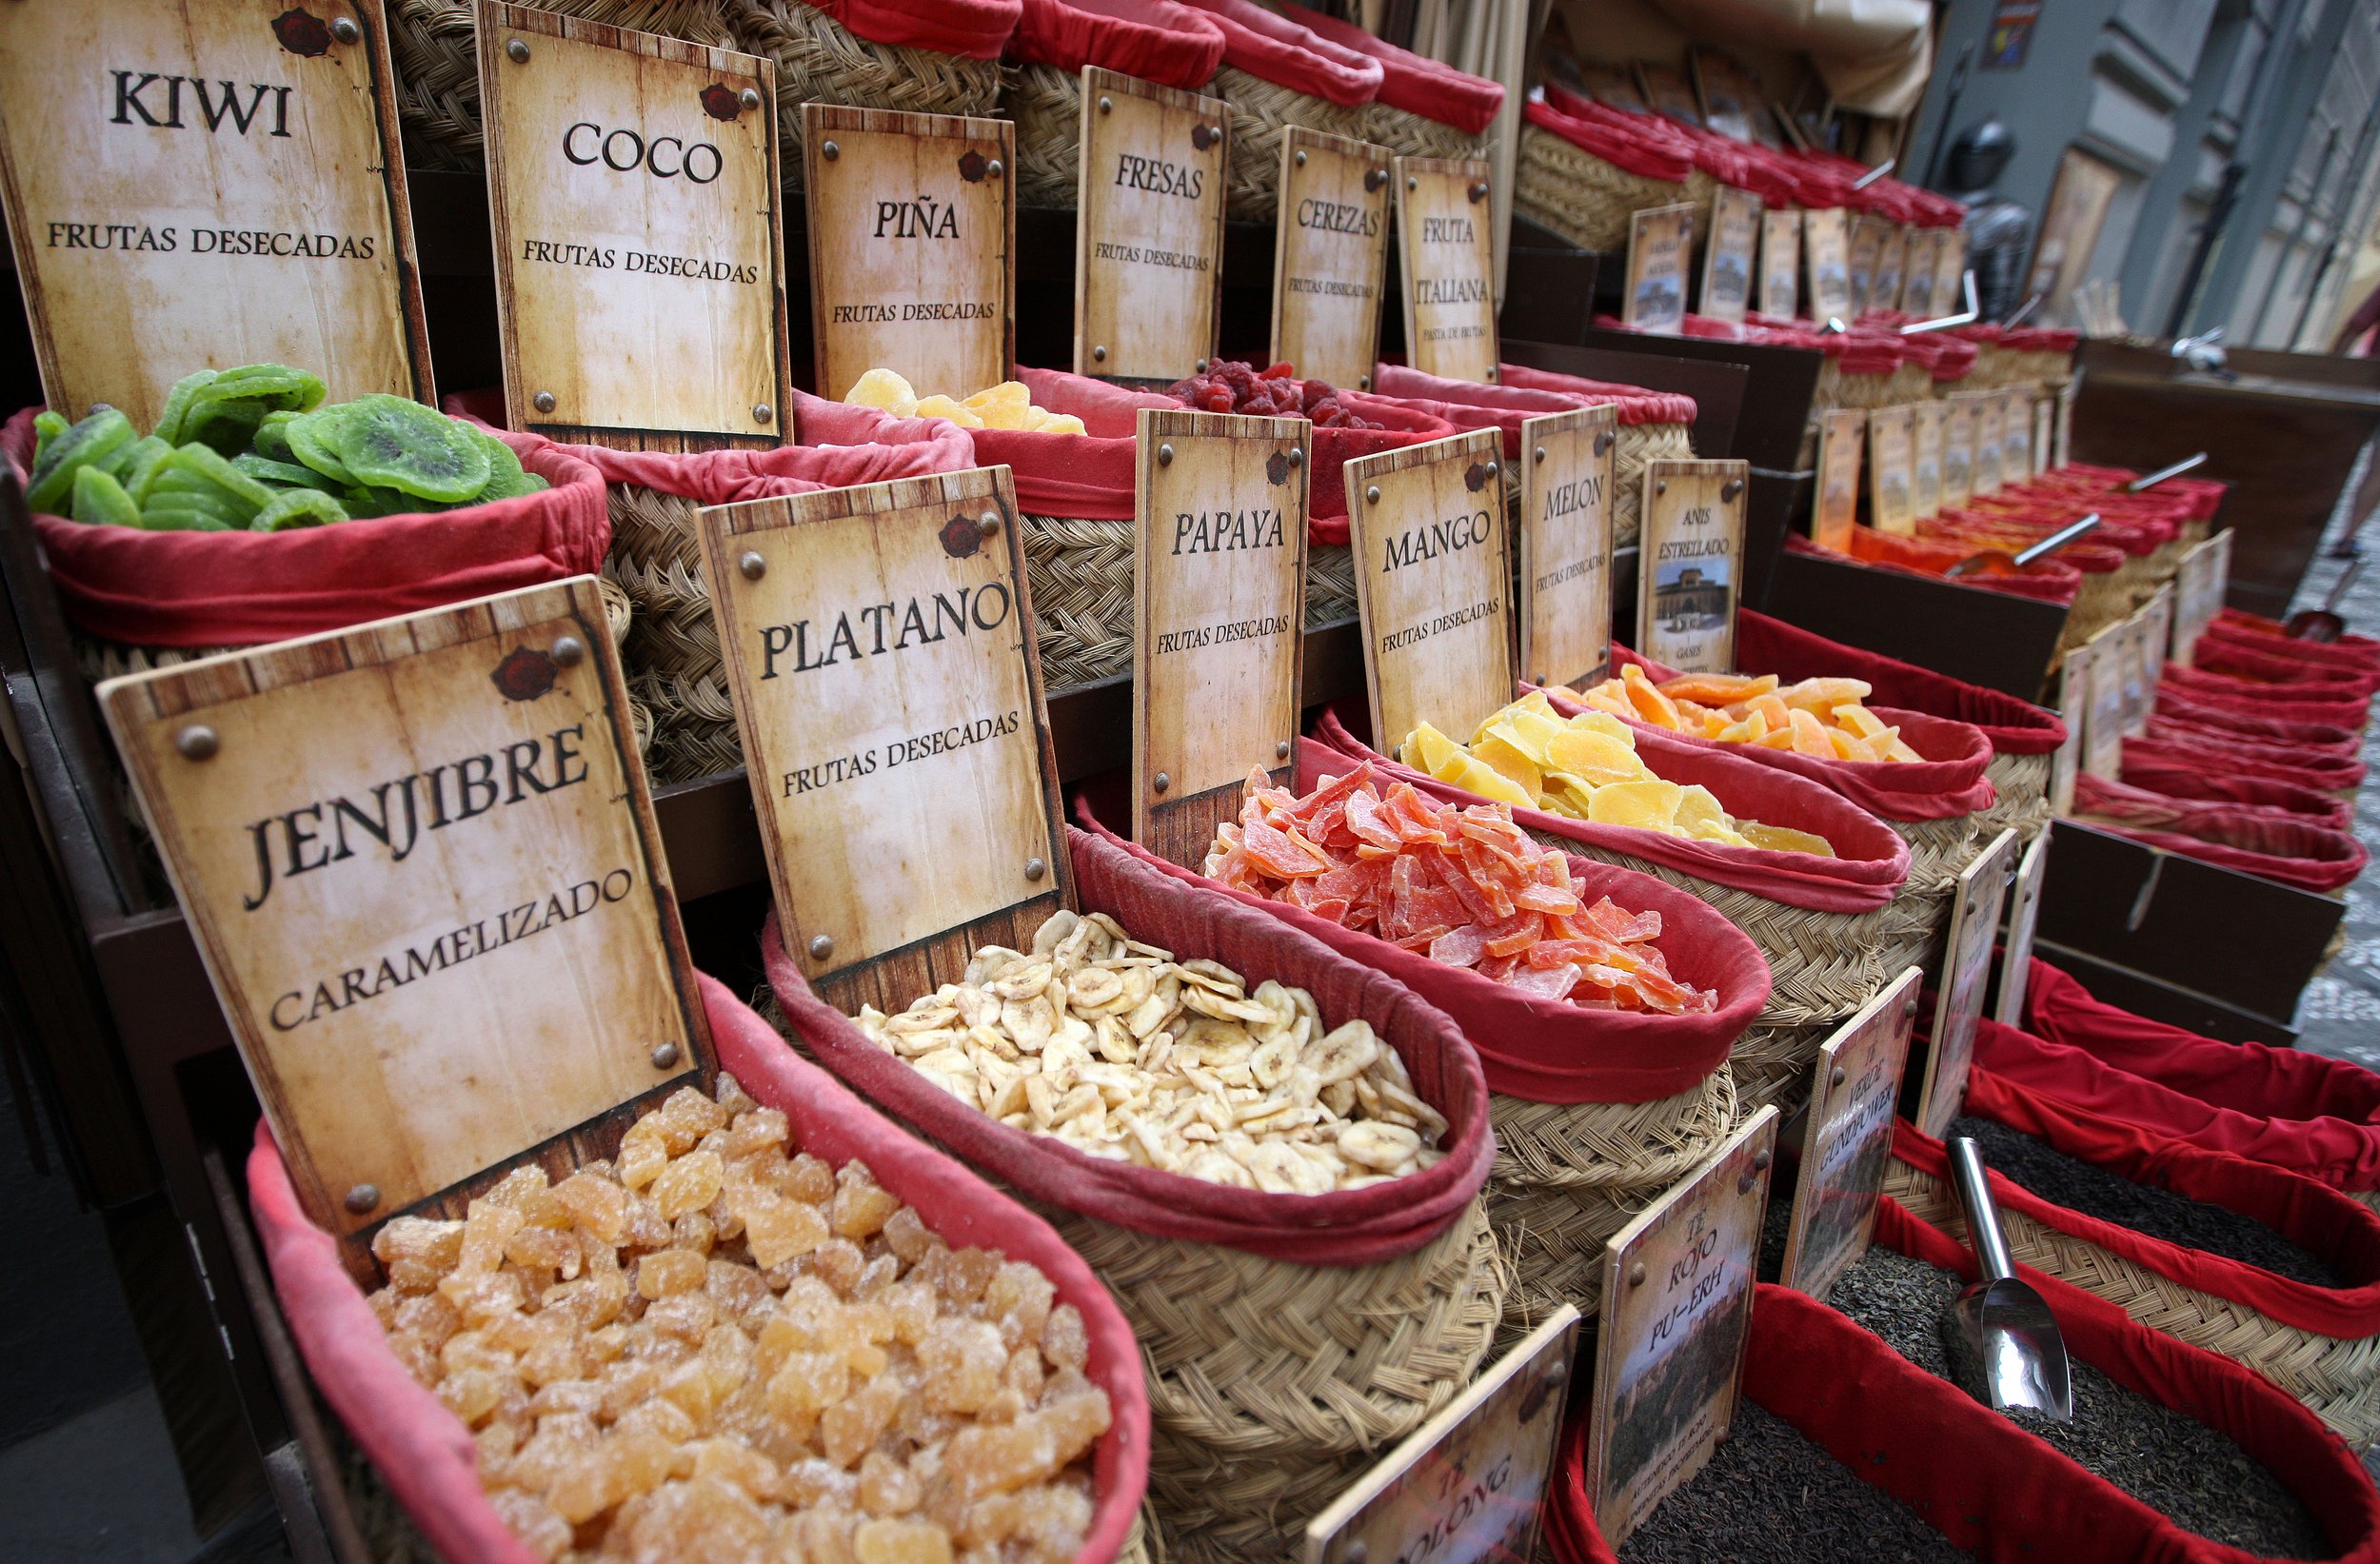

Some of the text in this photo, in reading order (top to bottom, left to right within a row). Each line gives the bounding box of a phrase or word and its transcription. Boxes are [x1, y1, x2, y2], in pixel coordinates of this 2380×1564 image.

[109, 69, 292, 137] KIWI
[563, 122, 724, 185] COCO
[1115, 153, 1203, 200] FRESAS
[874, 194, 960, 239] PIÑA
[1298, 198, 1379, 238] CEREZAS
[1423, 217, 1474, 244] FRUTA
[48, 222, 375, 261] FRUTAS DESECADAS
[523, 239, 758, 285] FRUTAS DESECADAS
[1095, 242, 1209, 272] FRUTAS DESECADAS
[1288, 277, 1375, 299] FRUTAS DESECADAS
[1416, 278, 1489, 306] ITALIANA
[833, 302, 995, 324] FRUTAS DESECADAS
[1543, 474, 1605, 521] MELON
[1682, 507, 1712, 525] ANIS
[1172, 507, 1284, 556] PAPAYA
[1382, 509, 1491, 572] MANGO
[1658, 538, 1730, 560] ESTRELLADO
[1536, 552, 1606, 594] FRUTAS DESECADAS
[759, 582, 1010, 682] PLATANO
[1157, 614, 1289, 654] FRUTAS DESECADAS
[1382, 597, 1499, 654] FRUTAS DESECADAS
[782, 711, 1019, 798] FRUTAS DESECADAS
[243, 723, 589, 912] JENJIBRE
[268, 868, 632, 1031] CARAMELIZADO
[1849, 1059, 1884, 1107] VERDE
[1687, 1208, 1707, 1242] TE
[1668, 1228, 1717, 1294] ROJO
[1649, 1258, 1725, 1353] PU-ERH
[1395, 1454, 1512, 1564] OLONG
